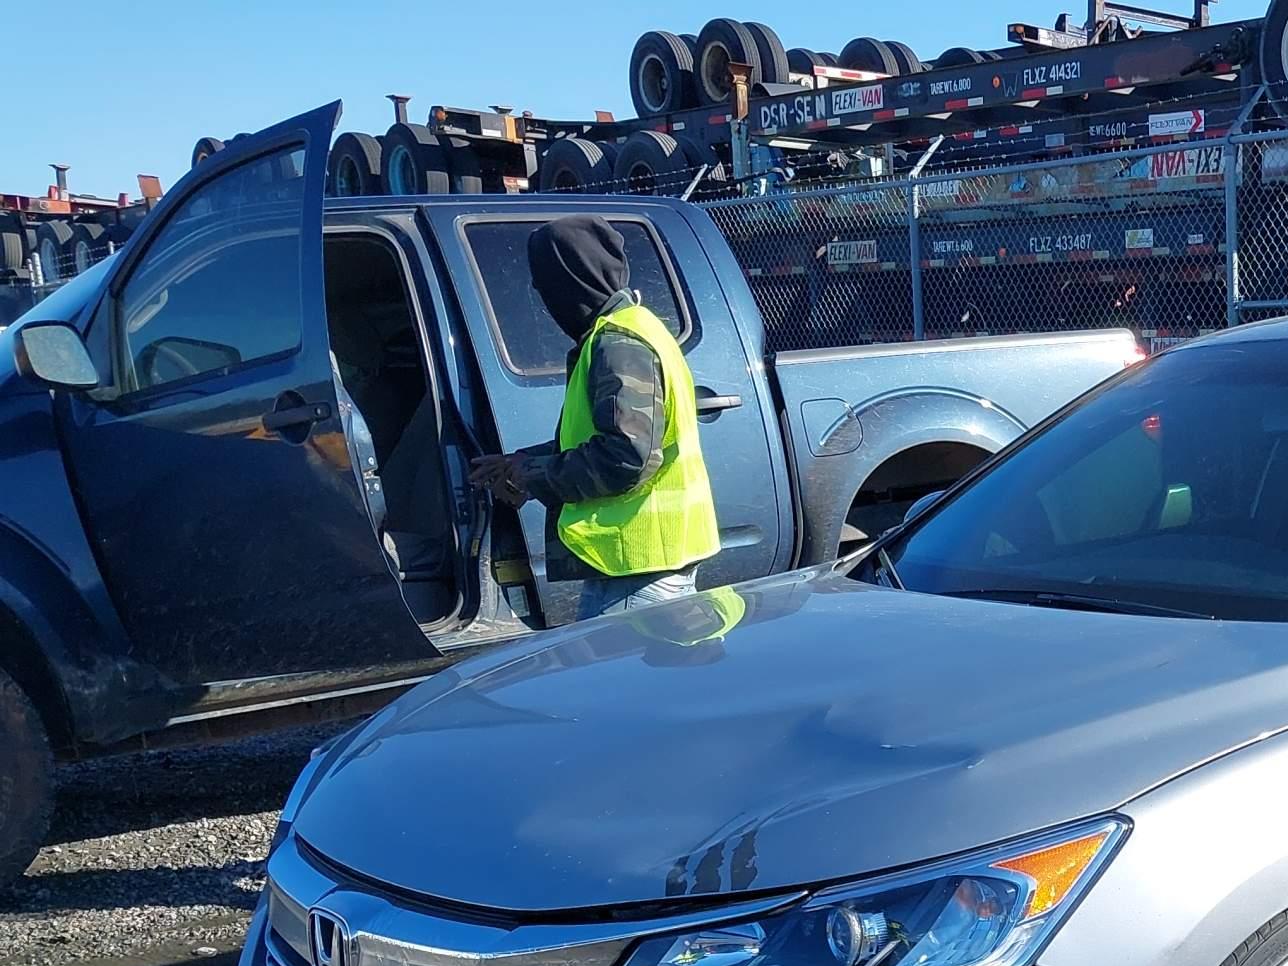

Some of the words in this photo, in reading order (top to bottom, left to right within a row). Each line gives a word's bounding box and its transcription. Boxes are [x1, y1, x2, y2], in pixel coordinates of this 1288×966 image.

[1023, 67, 1046, 86] FLXZ
[1050, 61, 1081, 80] 414321
[833, 88, 882, 112] FLEXI-VAN
[828, 241, 877, 263] FLEXI-VAN
[1029, 235, 1052, 252] FLXZ
[1055, 233, 1092, 250] 433487
